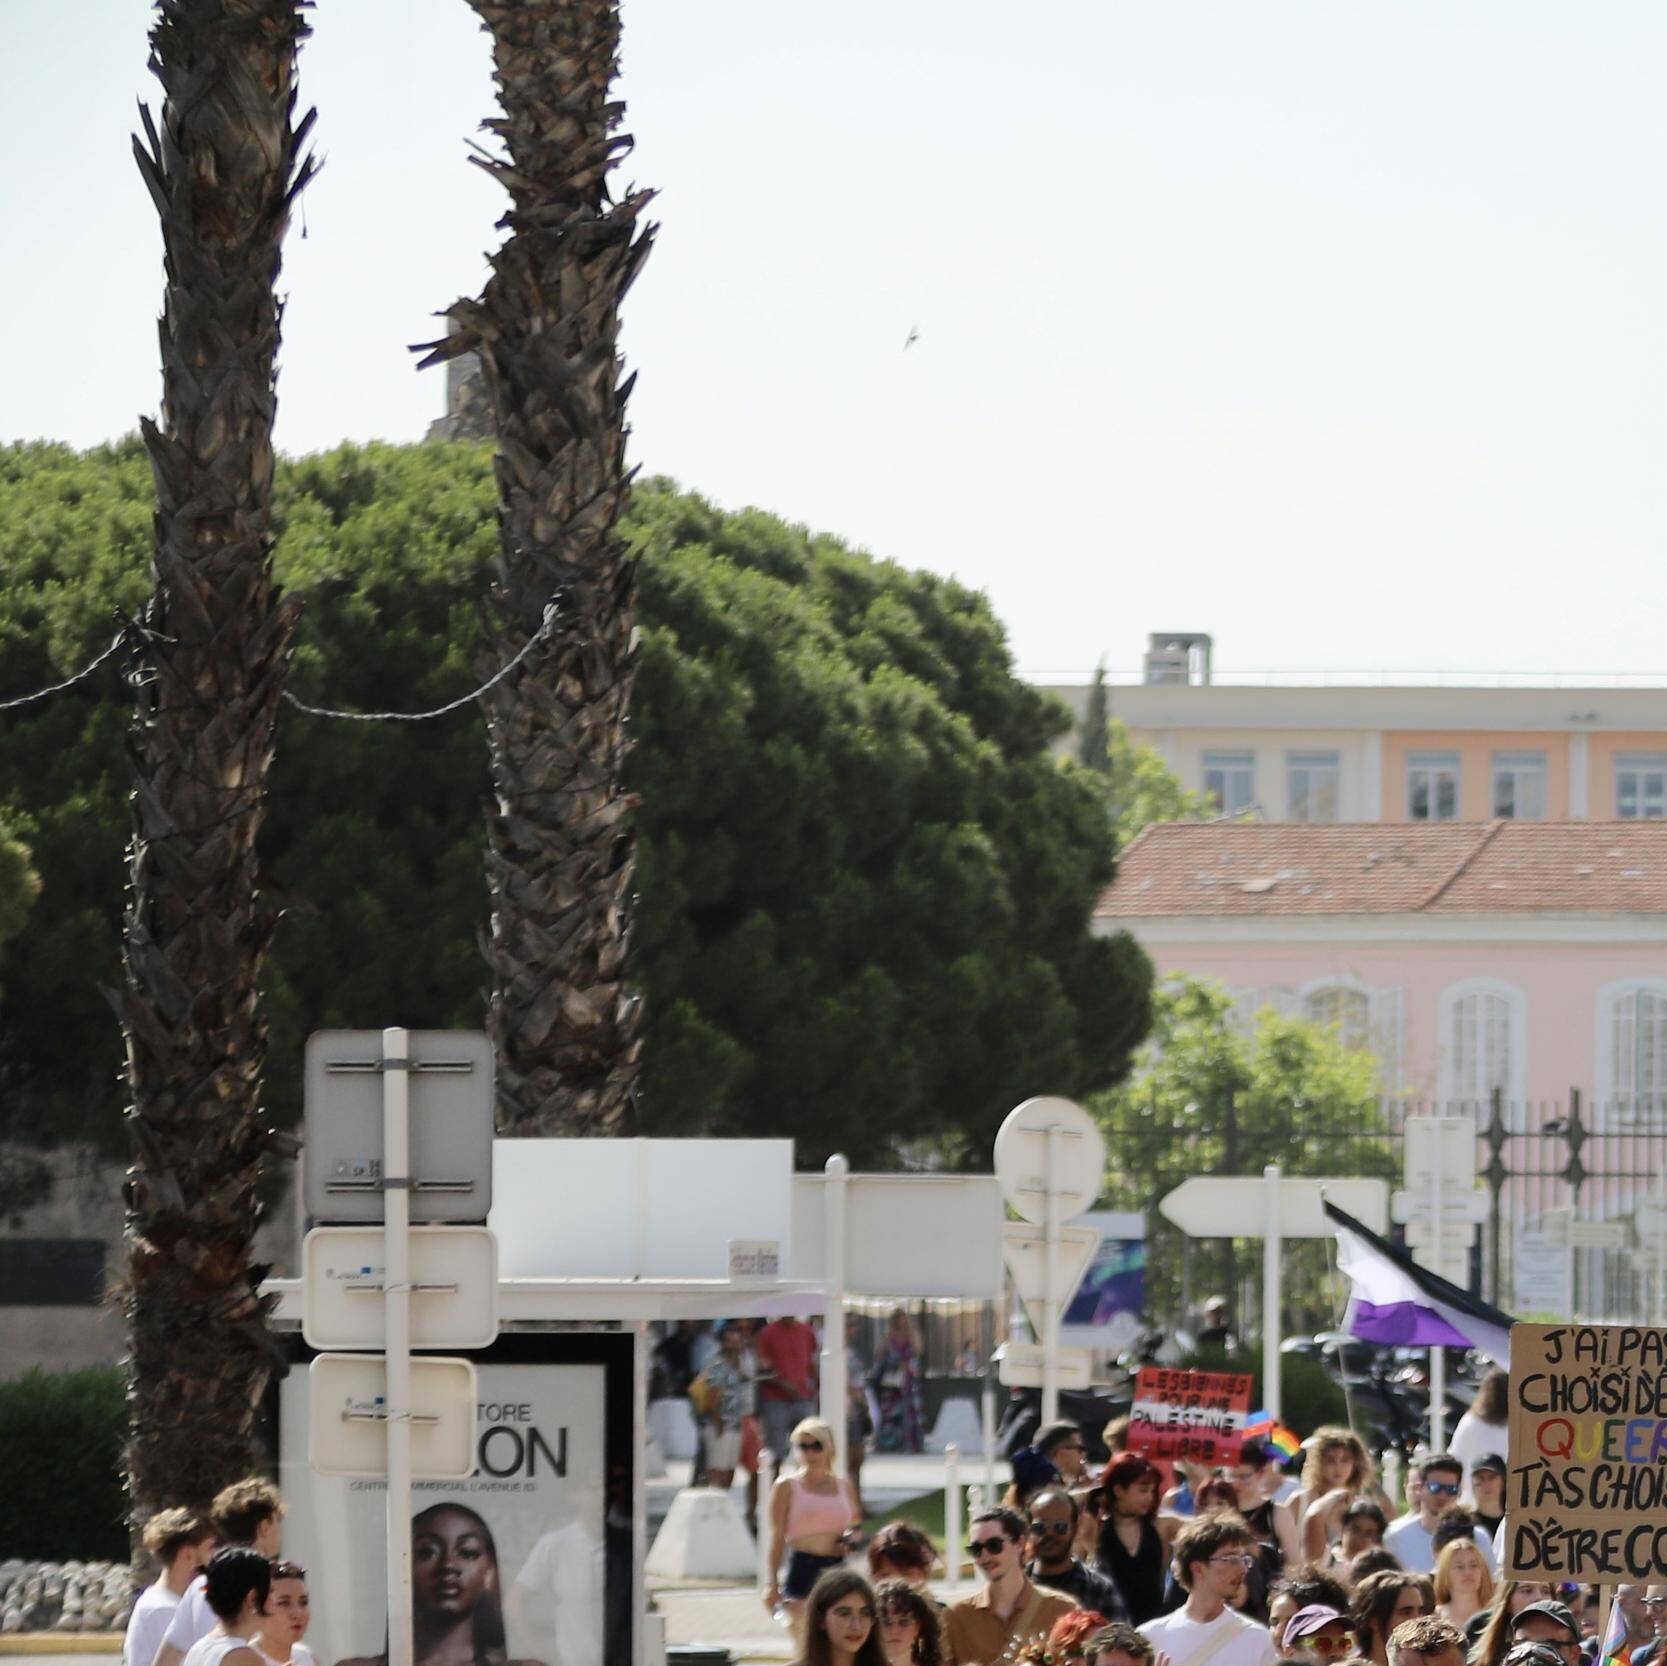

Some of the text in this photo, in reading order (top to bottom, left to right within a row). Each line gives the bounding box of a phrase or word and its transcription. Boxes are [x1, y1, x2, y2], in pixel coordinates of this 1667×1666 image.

[1142, 1370, 1248, 1395] LESBIENNES
[477, 1403, 531, 1422] TORE
[1132, 1409, 1236, 1438] PALESTINE
[473, 1426, 567, 1478] ON
[1156, 1438, 1215, 1461] LIBRE
[350, 1481, 388, 1492] CENTR
